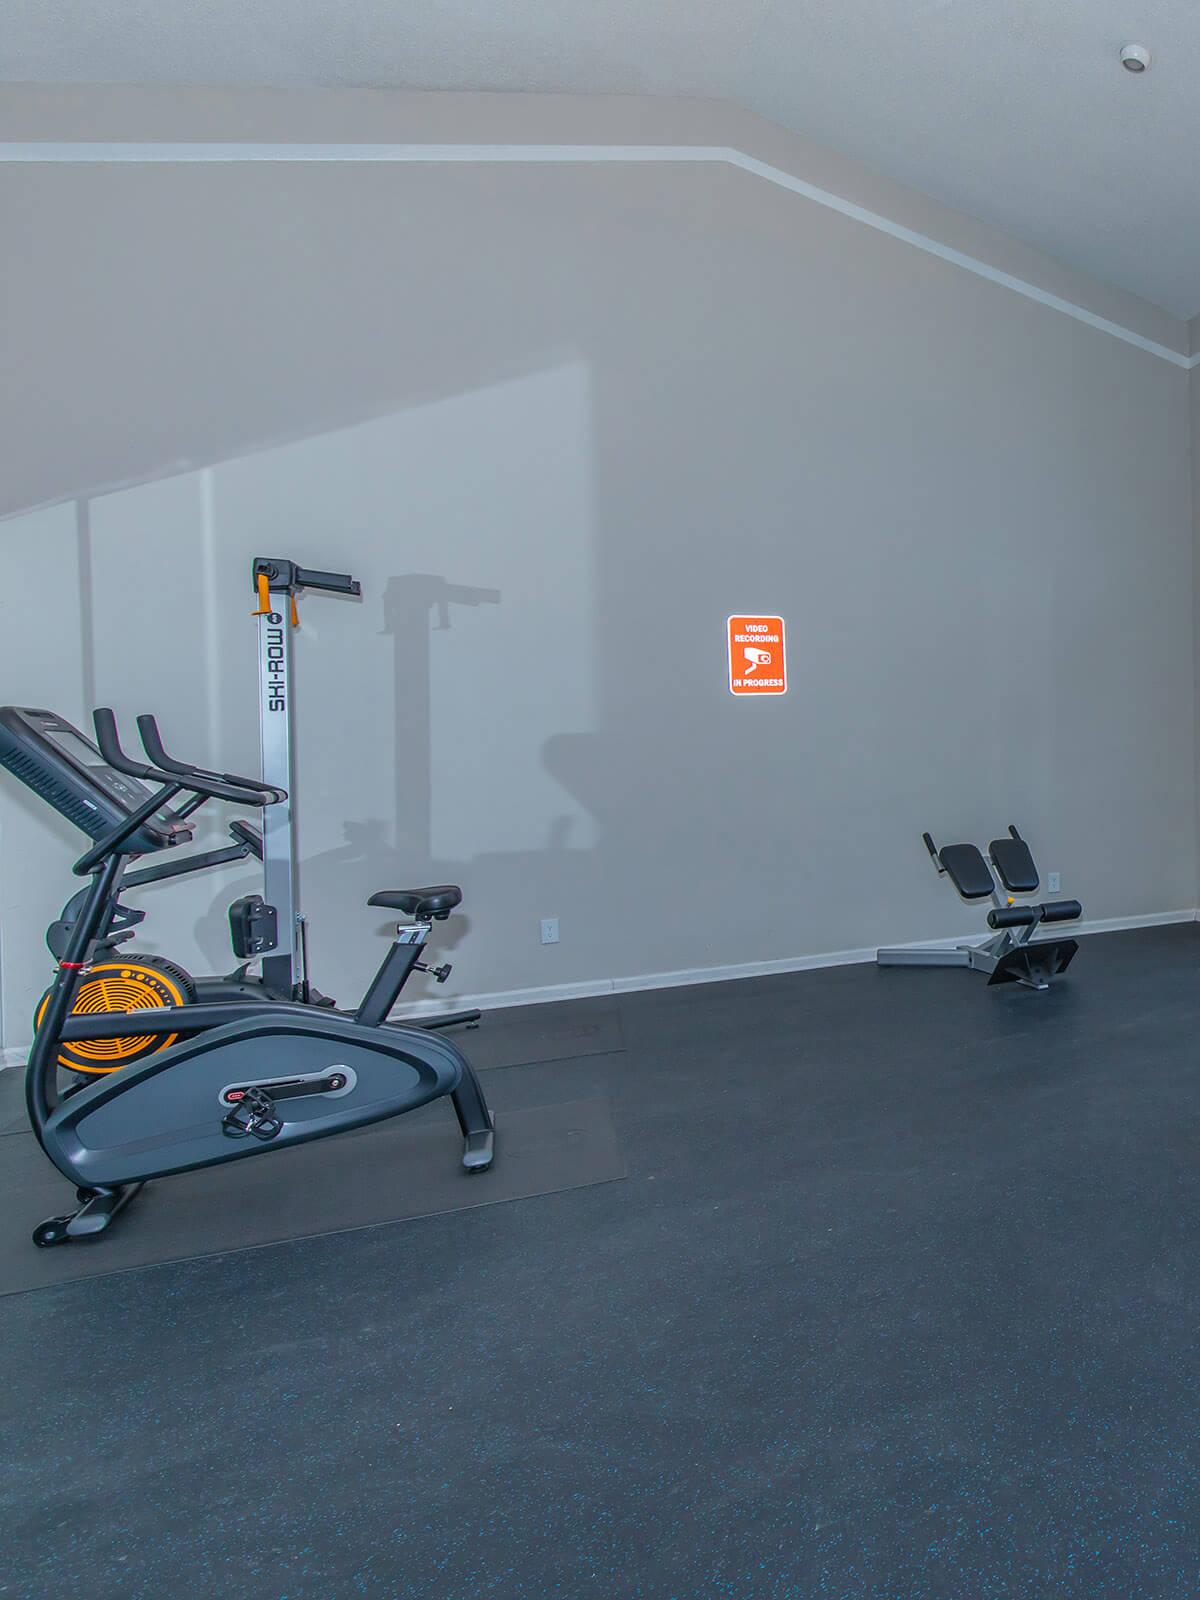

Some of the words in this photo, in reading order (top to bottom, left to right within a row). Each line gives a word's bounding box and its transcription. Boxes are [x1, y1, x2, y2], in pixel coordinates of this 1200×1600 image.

[745, 624, 768, 632] VIDEO
[734, 634, 779, 643] RECORDING
[267, 628, 285, 711] SKI-ROW
[733, 679, 741, 687] IN
[743, 679, 783, 687] PROGRESS
